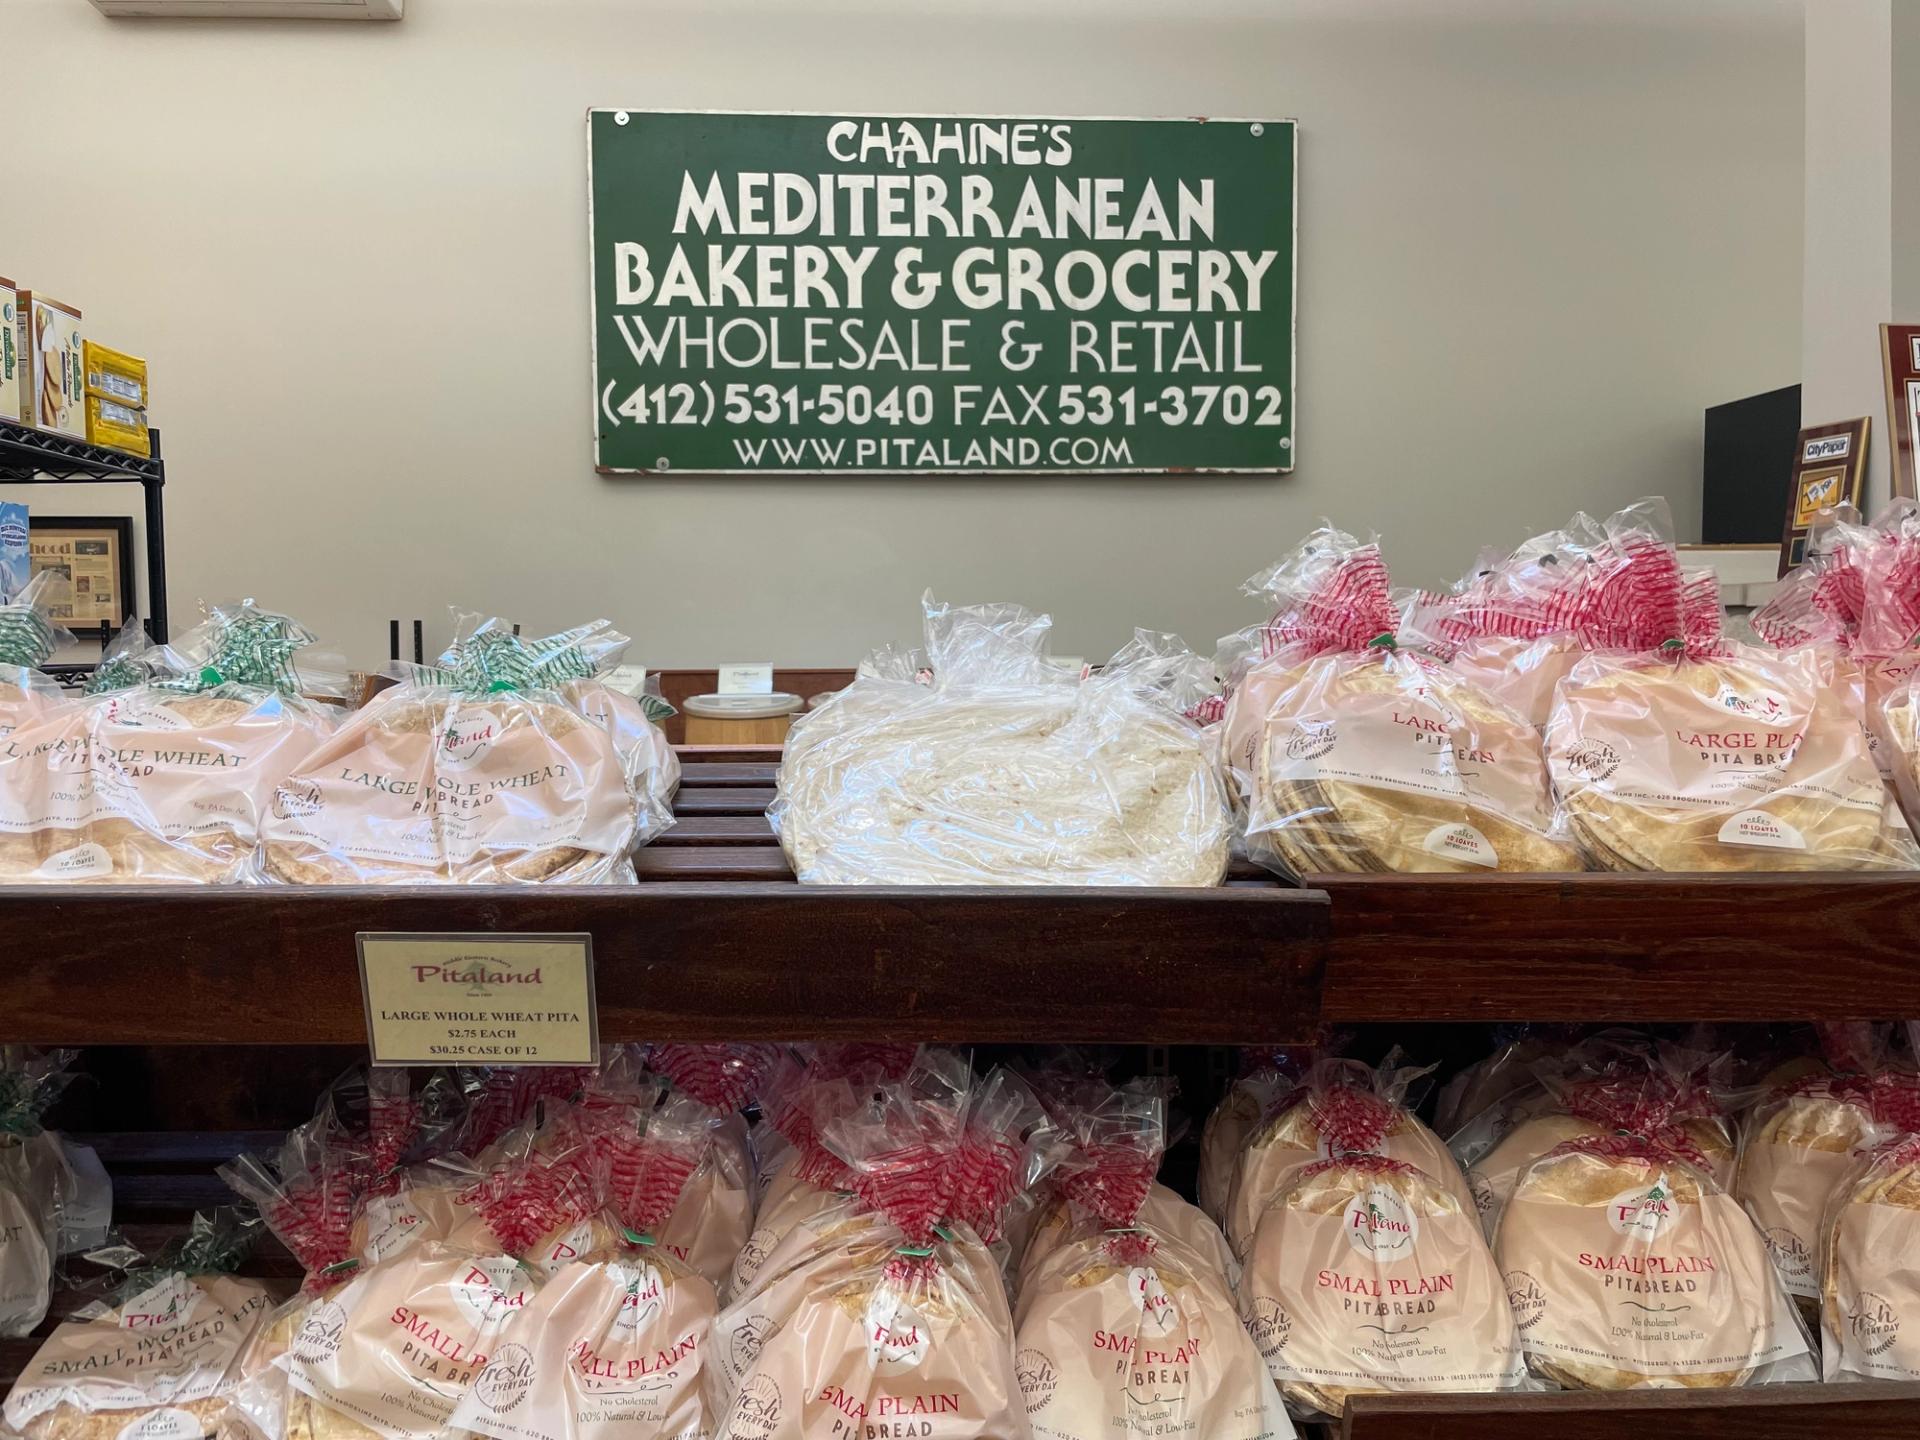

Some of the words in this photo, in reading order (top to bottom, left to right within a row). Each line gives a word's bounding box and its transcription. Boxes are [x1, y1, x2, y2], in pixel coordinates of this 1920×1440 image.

[826, 120, 1073, 169] CHAHINE'S
[671, 169, 1215, 242] MEDITERRANEAN
[614, 242, 880, 309] BAKERY
[890, 246, 942, 311] &
[952, 247, 1278, 313] GROCERY
[612, 314, 971, 371] WHOLESALE
[999, 319, 1043, 373] &
[1070, 320, 1263, 373] RETAIL
[601, 378, 715, 427] (412)
[724, 383, 934, 427] 531-5040
[953, 384, 1051, 426] FAX
[1058, 383, 1282, 427] 531-3702
[732, 436, 1134, 467] WWW.PITALAND.COM
[1301, 738, 1323, 753] EVERY
[1323, 735, 1338, 743] DAY
[1676, 730, 1758, 749] LARGE
[153, 749, 247, 767] WHEAT
[1700, 751, 1743, 765] PITA
[340, 767, 418, 796] LARGE
[489, 764, 569, 789] WHEAT
[438, 791, 493, 809] BREAD
[1672, 795, 1712, 805] BROOKLINE
[1749, 824, 1779, 833] LOAVES
[1455, 836, 1479, 849] LOAVES
[411, 965, 543, 984] Pitaland
[381, 1010, 430, 1021] LARGE
[433, 1010, 488, 1022] WHOLE
[491, 1012, 544, 1023] WHEAT
[546, 1012, 579, 1023] PITA
[448, 1028, 477, 1039] $2.75
[480, 1029, 516, 1039] EACH
[429, 1045, 465, 1056] $30.25
[468, 1045, 501, 1055] CASE
[504, 1045, 522, 1055] OF
[525, 1045, 538, 1056] 12
[1647, 1255, 1717, 1275] PLAIN
[1390, 1273, 1454, 1296] PLAIN
[1508, 1282, 1546, 1305] esh
[1605, 1274, 1642, 1294] PITA
[1644, 1278, 1697, 1294] BREAD
[1344, 1299, 1383, 1317] PITA
[1380, 1299, 1436, 1317] BREAD
[1511, 1302, 1531, 1313] VERY
[1532, 1299, 1547, 1309] DAY
[305, 1319, 344, 1343] esh
[1277, 1322, 1292, 1333] DAY
[1631, 1316, 1642, 1327] No
[1884, 1322, 1900, 1333] DAY
[298, 1333, 324, 1346] EVERY
[325, 1341, 342, 1352] DAY
[390, 1306, 465, 1362] SMALL
[1372, 1339, 1385, 1348] No
[1672, 1330, 1704, 1341] Low-Fat
[126, 1349, 168, 1368] PITA
[402, 1341, 439, 1373] PITA
[626, 1333, 697, 1378] PLAIN
[1144, 1338, 1200, 1364] PLAN
[1352, 1347, 1376, 1358] 100%
[1415, 1346, 1447, 1357] Low-Fat
[1532, 1339, 1549, 1347] INC.
[1570, 1346, 1609, 1359] BROOKLINE
[1017, 1363, 1058, 1385] esh
[1314, 1368, 1354, 1378] BROOKLINE
[1355, 1372, 1374, 1380] BLVD.
[1375, 1375, 1417, 1383] PITTSBURGH,
[1450, 1373, 1466, 1382] (412)
[491, 1380, 517, 1393] EVERY
[517, 1377, 535, 1388] DAY
[1020, 1383, 1042, 1393] VERY
[1041, 1381, 1058, 1391] DAY
[408, 1390, 421, 1401] No
[600, 1397, 613, 1406] No
[614, 1395, 658, 1407] Cholesterol
[877, 1393, 960, 1416] PLAIN
[335, 1397, 373, 1418] BROOKLINE
[381, 1392, 404, 1408] 100%
[406, 1402, 440, 1422] Natural
[576, 1412, 601, 1424] 100%
[603, 1411, 635, 1423] Natural
[636, 1410, 646, 1421] &
[736, 1410, 762, 1427] EVERY
[761, 1419, 779, 1433] DAY
[475, 1415, 506, 1430] PITALAND
[506, 1425, 519, 1433] INC.
[525, 1429, 541, 1439] 620
[866, 1420, 933, 1440] BREAD
[1057, 1431, 1070, 1440] 620
[1155, 1425, 1164, 1436] &
[1165, 1420, 1196, 1434] Low-Fat
